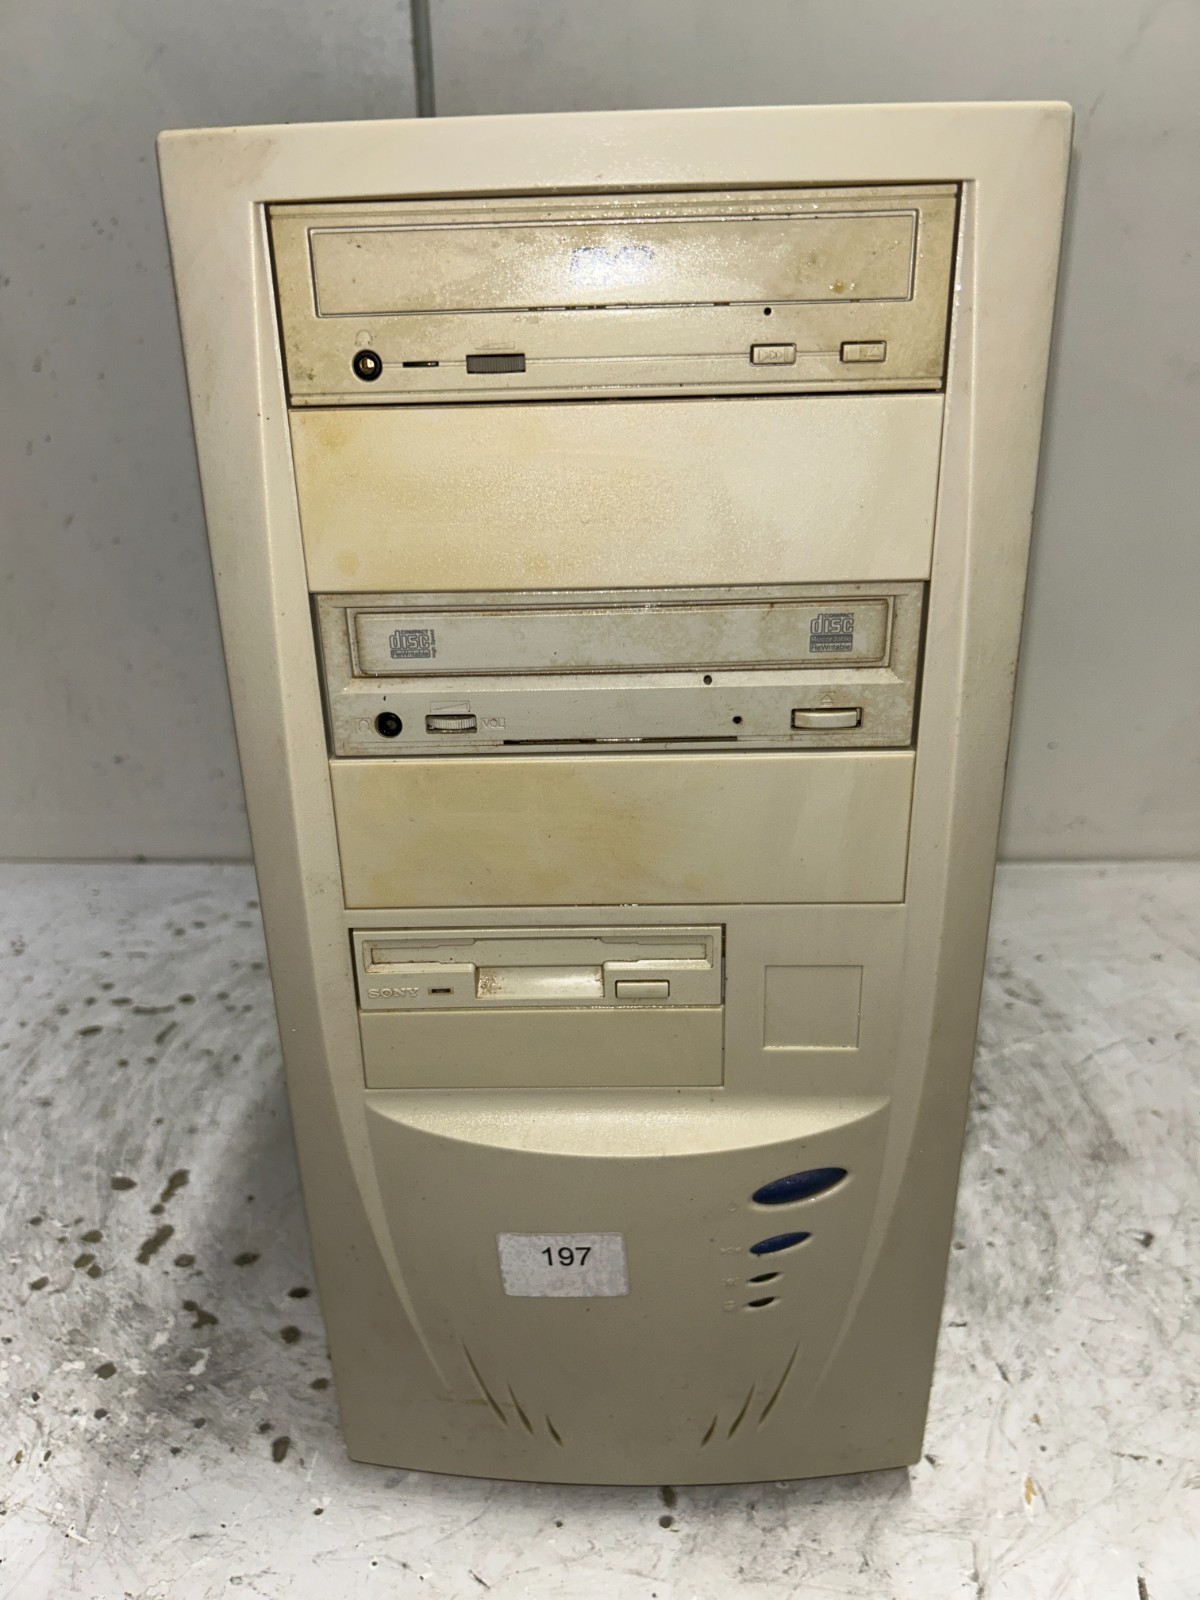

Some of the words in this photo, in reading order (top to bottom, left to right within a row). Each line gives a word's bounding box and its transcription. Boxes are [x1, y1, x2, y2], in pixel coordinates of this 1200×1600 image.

[811, 613, 854, 634] disc
[389, 629, 430, 650] disc
[368, 987, 419, 998] SONY
[541, 1246, 592, 1267] 197
